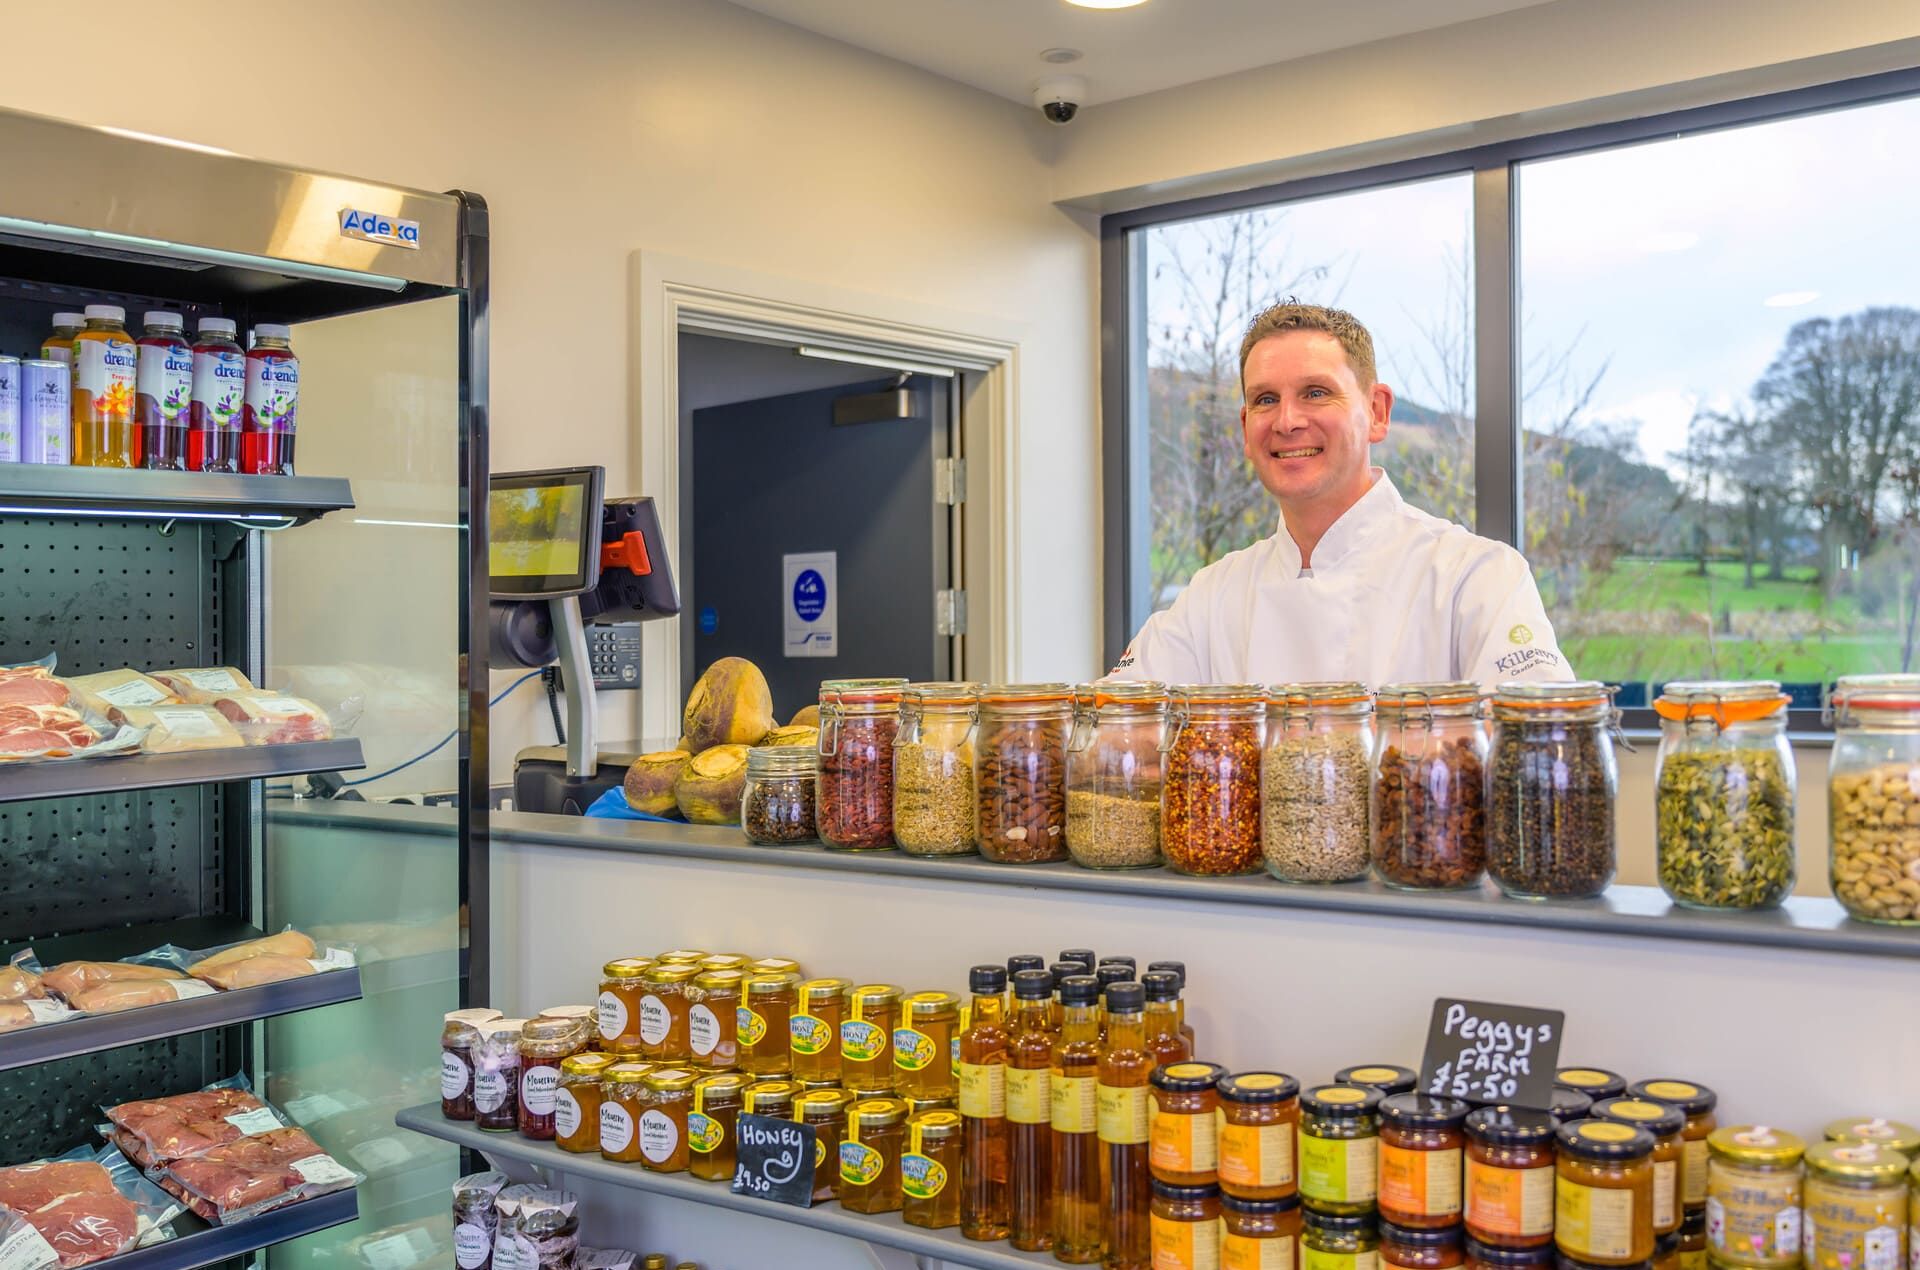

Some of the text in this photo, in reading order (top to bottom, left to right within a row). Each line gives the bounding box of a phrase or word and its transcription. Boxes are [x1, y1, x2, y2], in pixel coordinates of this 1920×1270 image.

[344, 210, 418, 241] Adexa
[261, 367, 298, 383] drench
[1444, 1004, 1552, 1056] Peggys
[1456, 1048, 1530, 1076] FARM
[643, 1118, 668, 1131] Mourne
